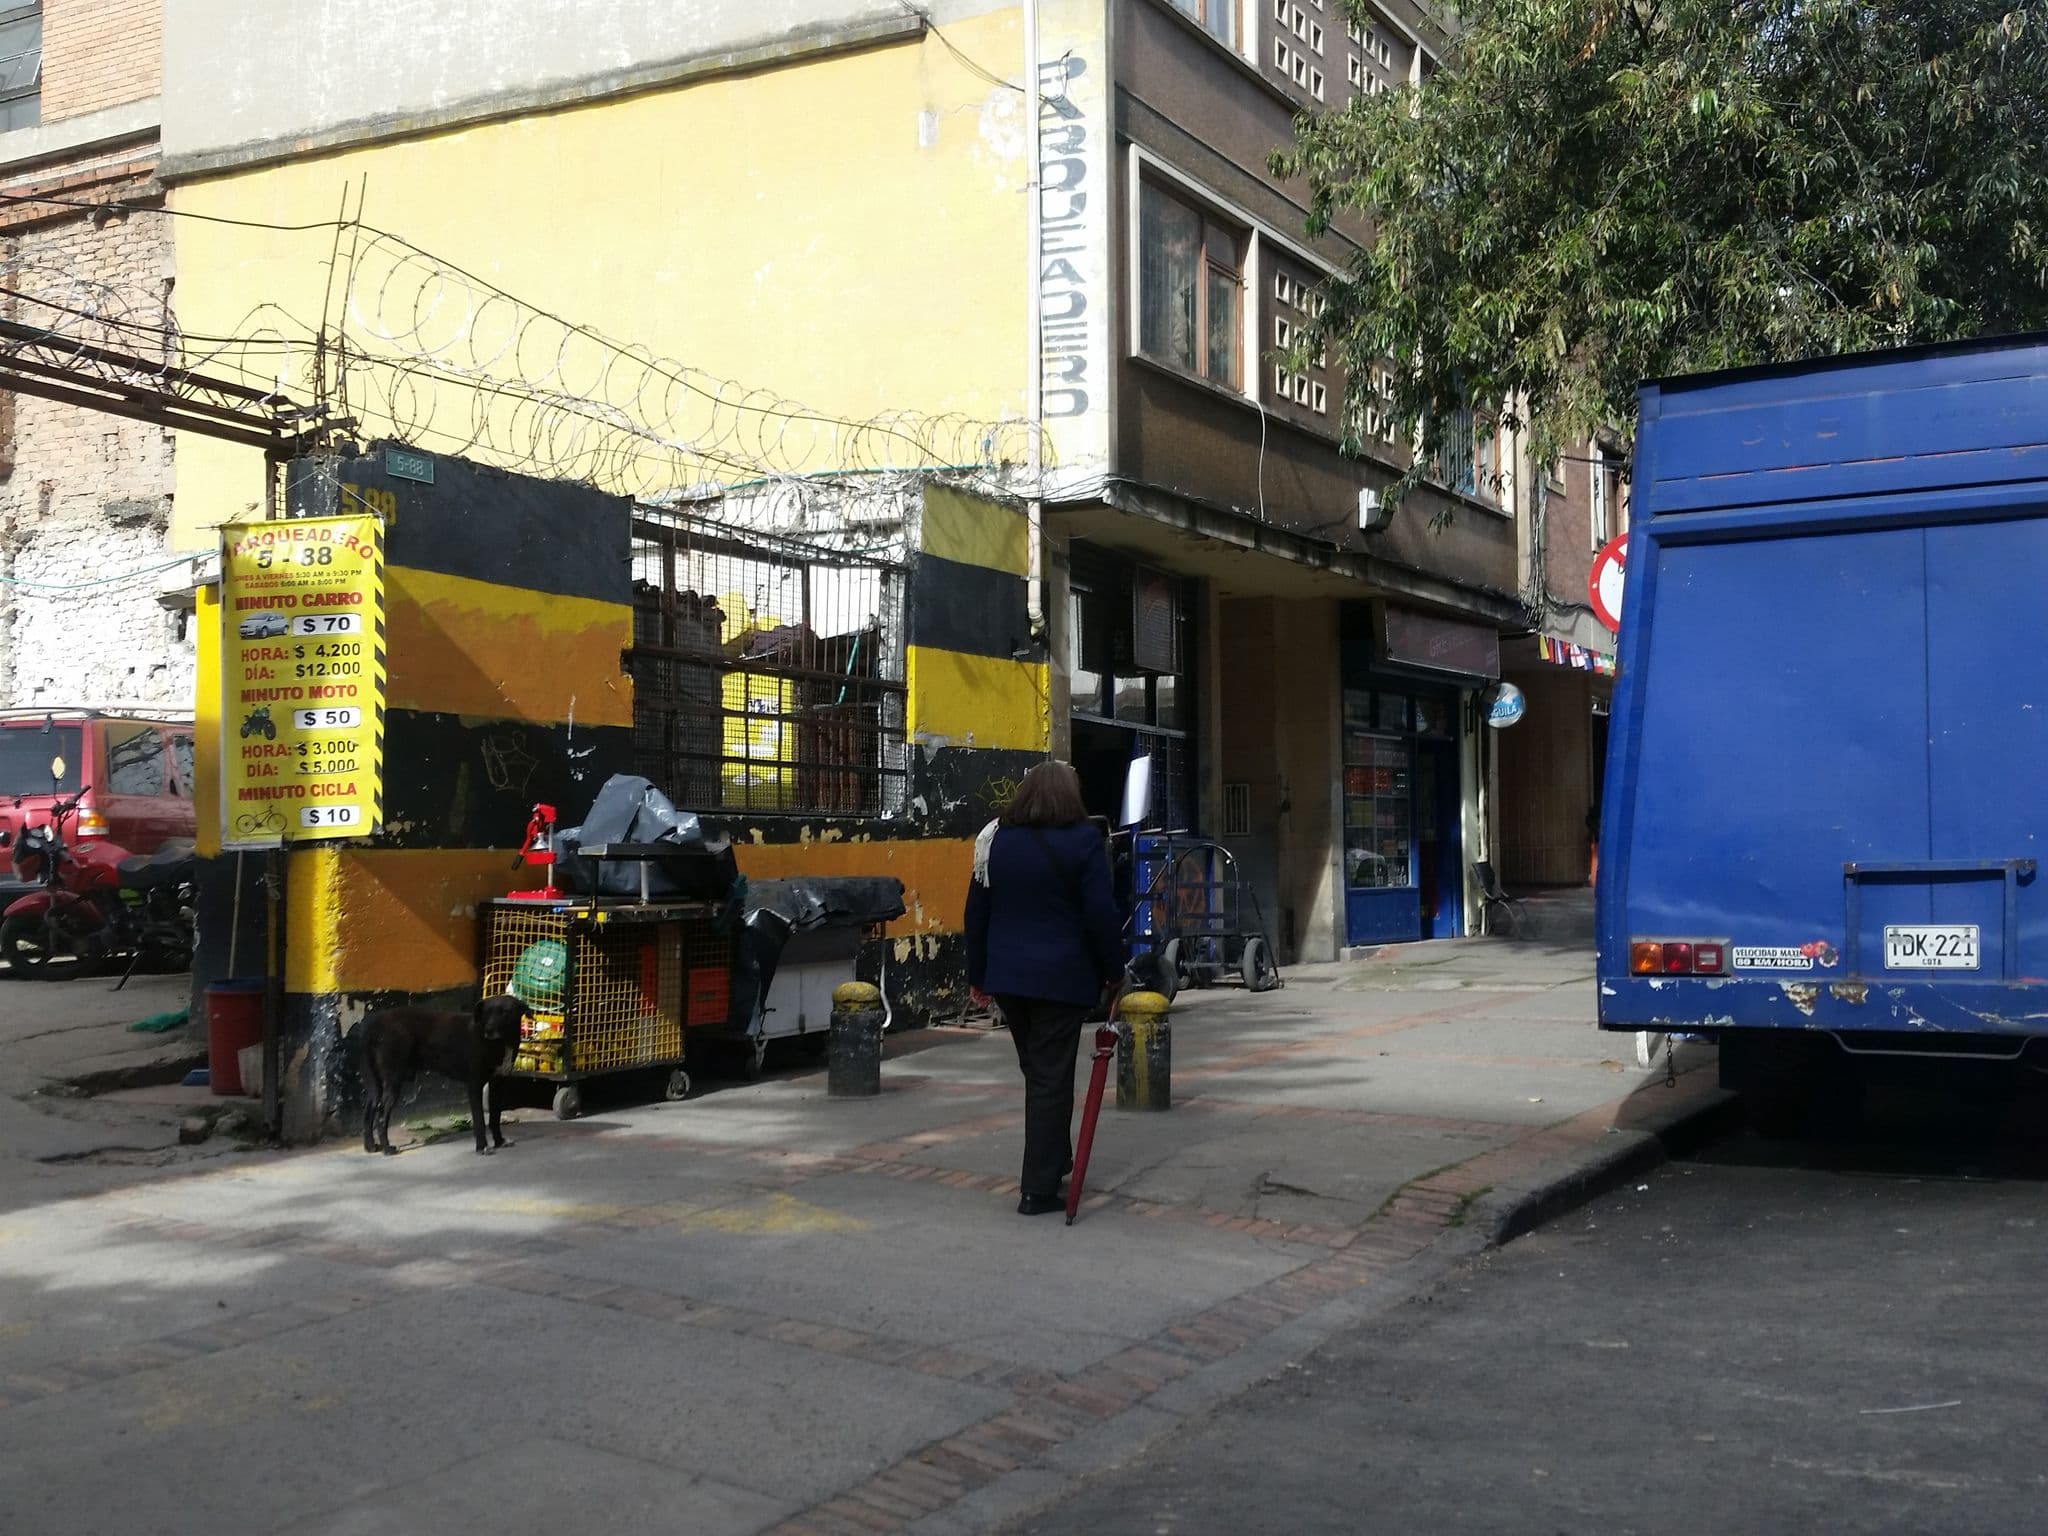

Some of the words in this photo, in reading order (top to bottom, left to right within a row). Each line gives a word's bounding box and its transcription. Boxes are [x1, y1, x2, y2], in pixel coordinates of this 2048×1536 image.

[397, 455, 424, 476] 5-88
[297, 579, 309, 587] AM
[334, 577, 347, 585] PM
[350, 569, 363, 577] PM
[235, 594, 297, 611] MINUTO
[302, 591, 363, 607] CARRO
[303, 617, 316, 634] $
[323, 616, 351, 632] 70
[240, 646, 289, 663] HORA:
[294, 643, 305, 660] $
[315, 642, 361, 658] 4.200
[295, 661, 361, 678] $12.000
[240, 686, 304, 704] MINUTO
[308, 684, 358, 701] MOTO
[303, 710, 317, 727] $
[325, 709, 351, 725] 50
[241, 744, 292, 760] HORA:
[298, 741, 308, 757] $
[312, 739, 357, 756] 3.000
[312, 758, 356, 774] 5.000
[238, 784, 306, 802] MINUTO
[309, 782, 357, 798] CICLA
[309, 808, 320, 825] $
[327, 807, 351, 823] 10
[1735, 948, 1778, 958] VELOCIDAD
[1780, 948, 1804, 958] MAXI
[1921, 957, 1943, 966] COTA
[1753, 957, 1810, 968] KM/HORA
